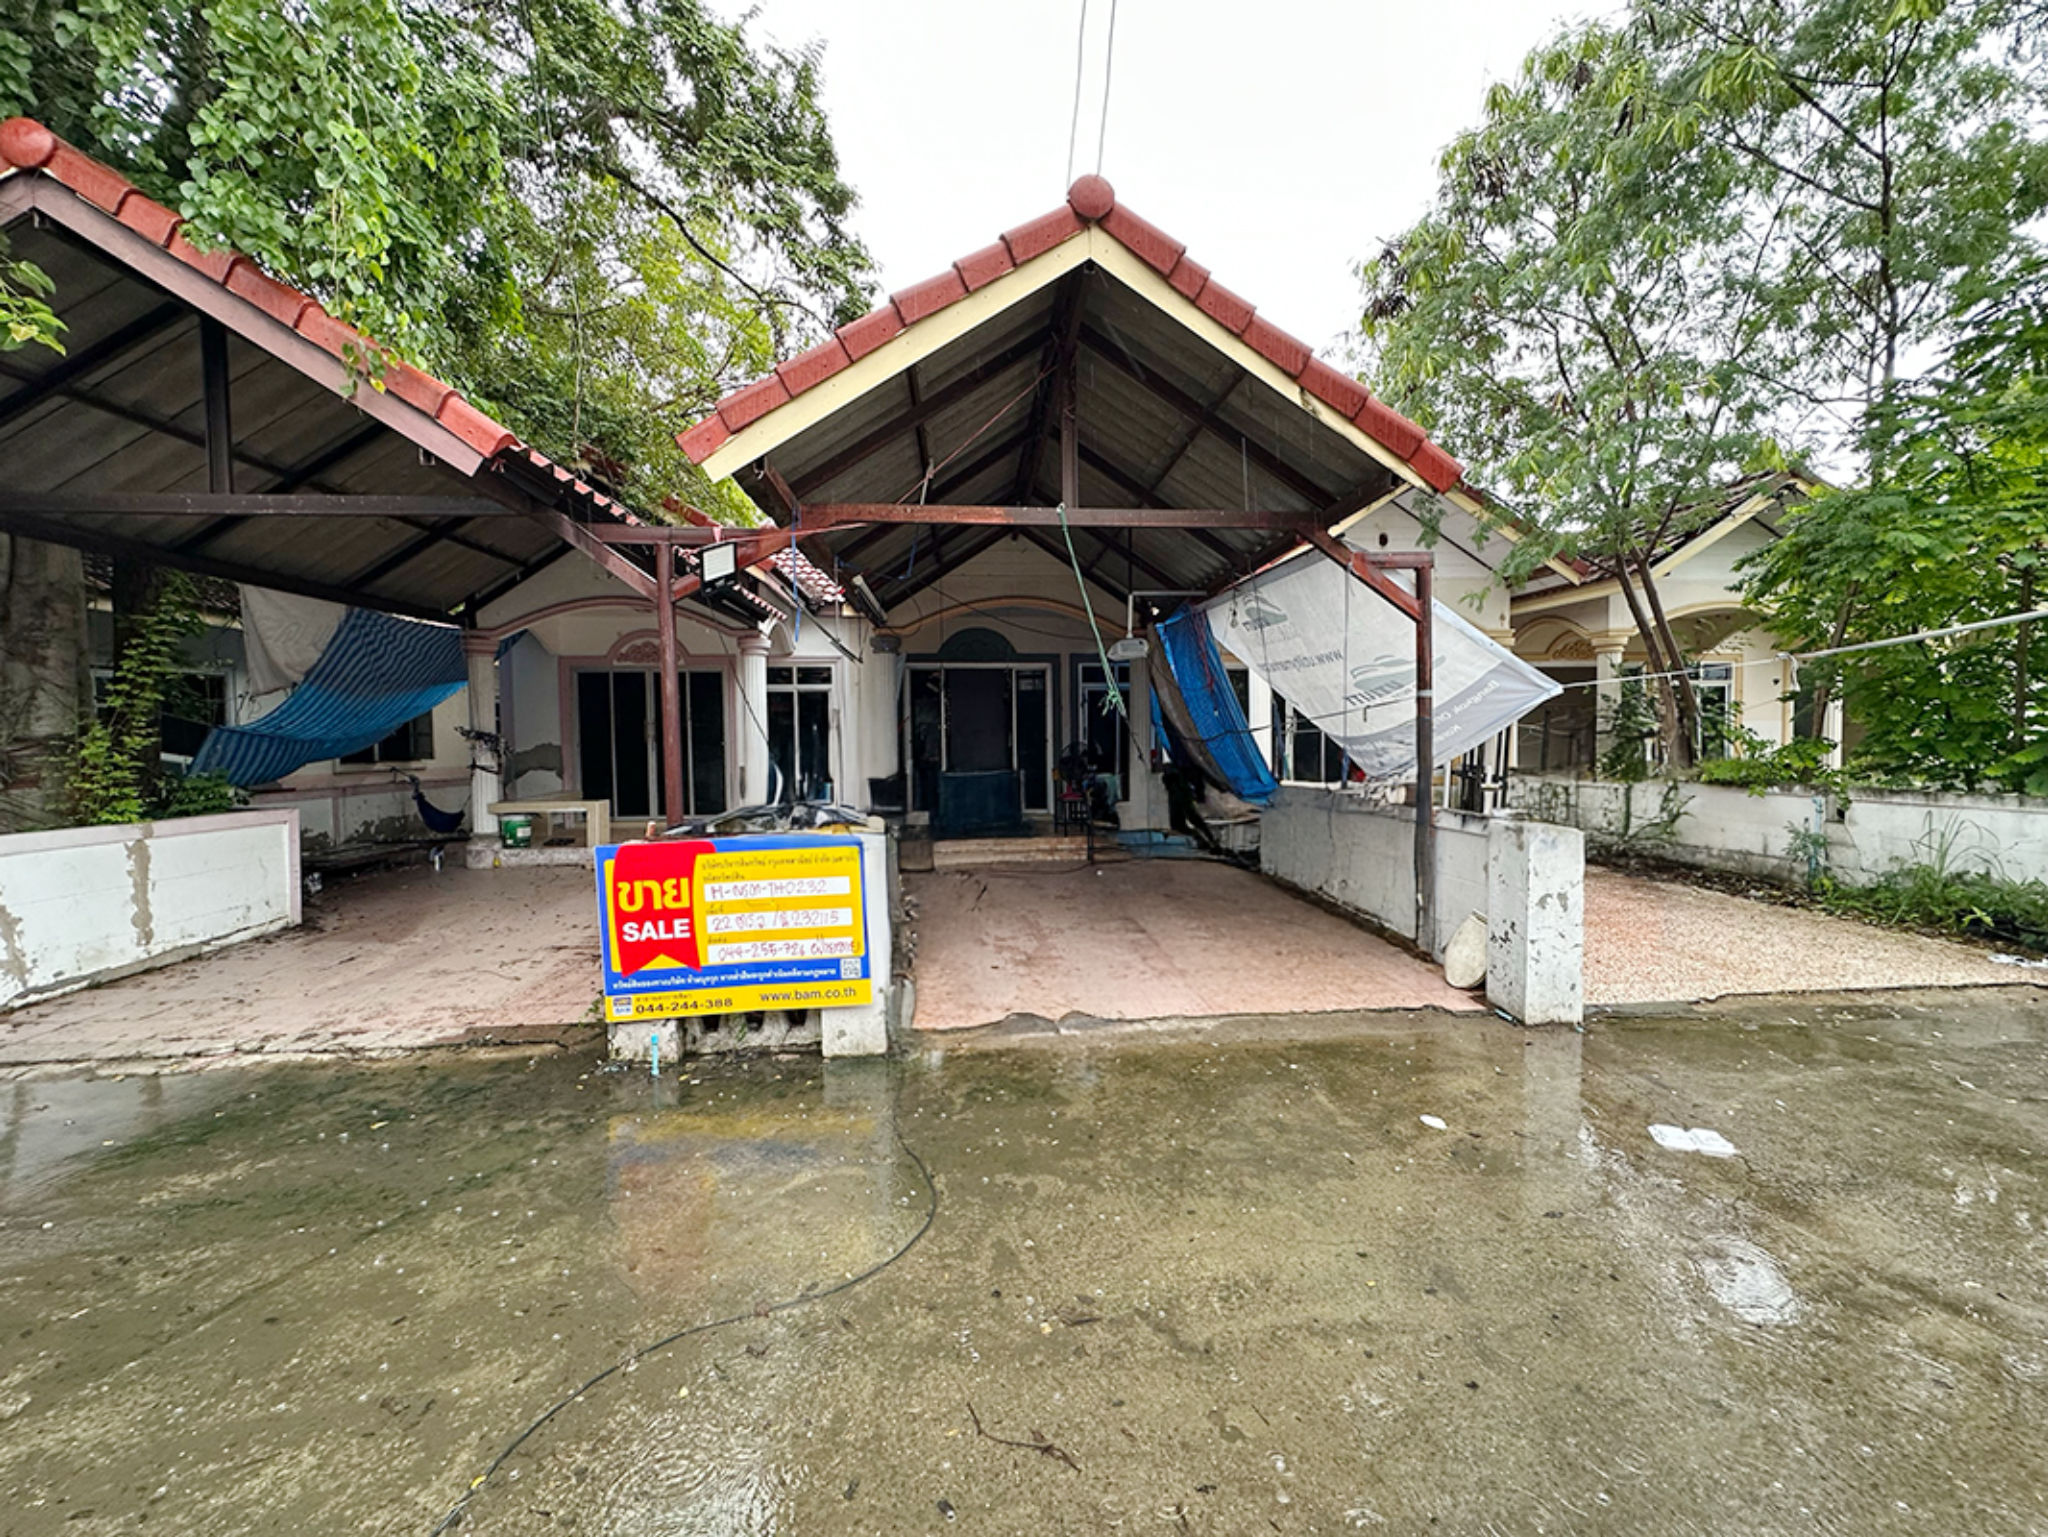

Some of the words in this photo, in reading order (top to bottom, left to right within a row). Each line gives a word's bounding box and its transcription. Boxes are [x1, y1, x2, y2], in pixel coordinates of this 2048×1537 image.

[617, 877, 691, 913] ขาย
[622, 918, 692, 942] SALE
[760, 987, 857, 1002] www.bam.co.th
[635, 998, 733, 1014] 044-244-388
